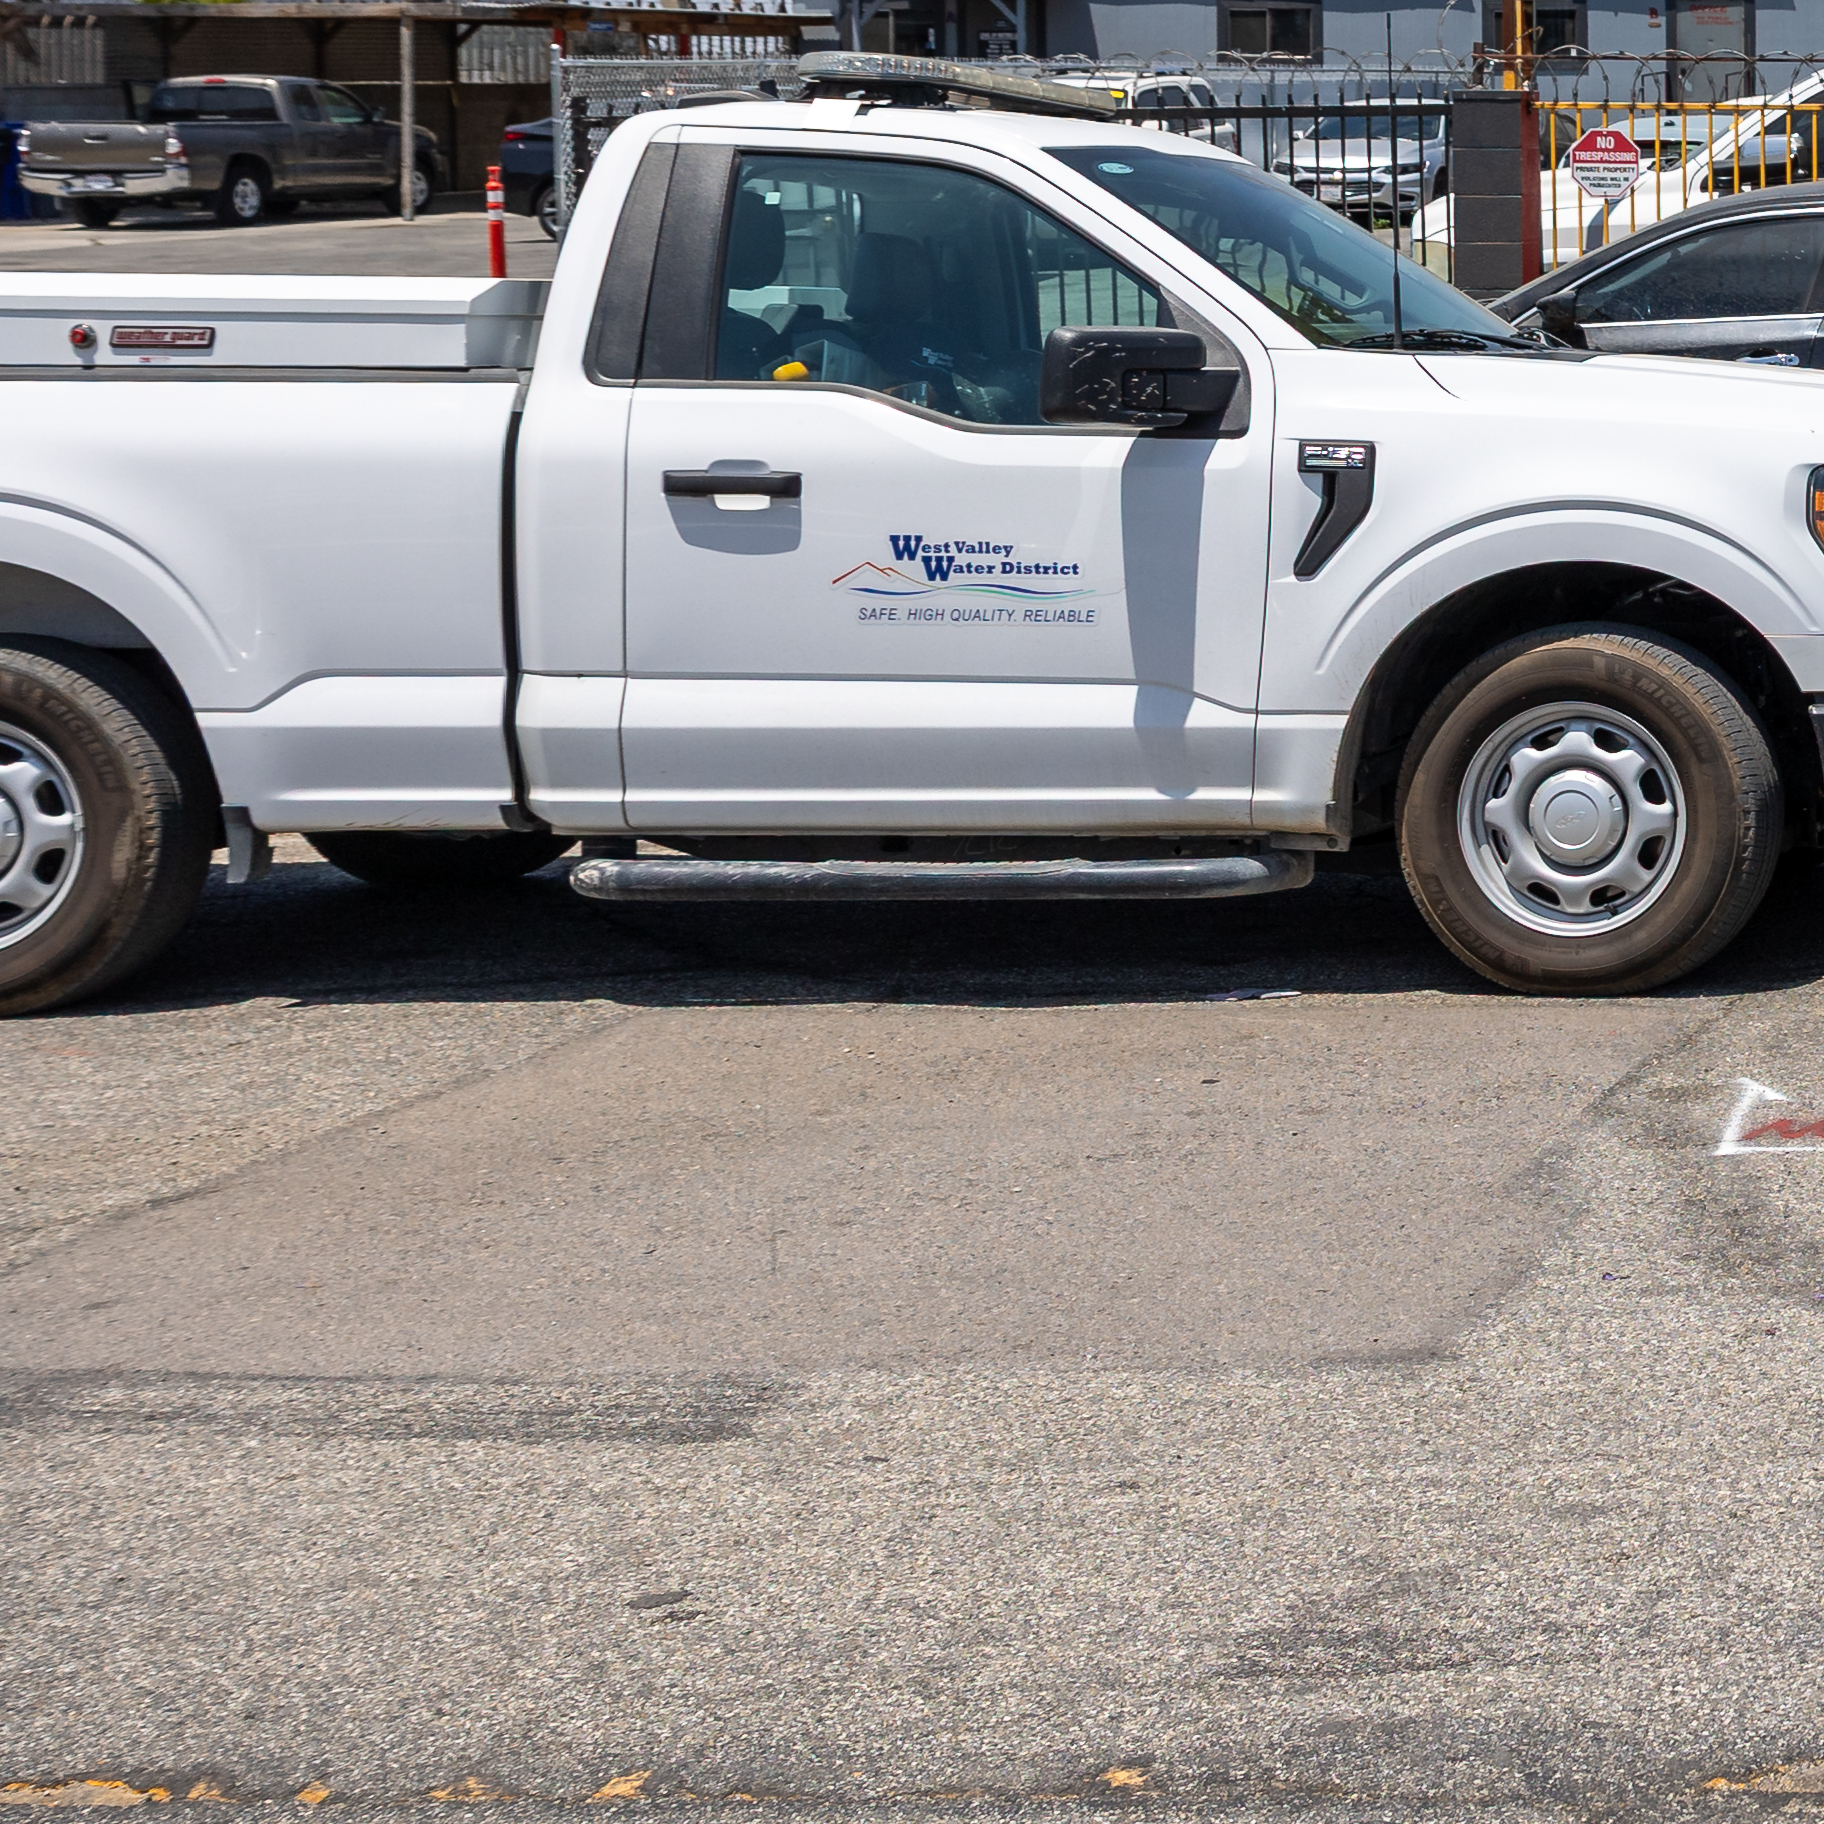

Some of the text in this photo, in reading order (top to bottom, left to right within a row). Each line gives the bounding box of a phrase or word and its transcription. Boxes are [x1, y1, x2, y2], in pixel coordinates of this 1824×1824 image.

[1596, 136, 1615, 149] NO
[1574, 151, 1637, 162] TRESPASSING
[1603, 166, 1635, 174] PROPERTY
[889, 534, 1014, 561] West Valley
[921, 555, 1079, 581] Water District
[858, 607, 1095, 623] SAFE. HIGH QUALITY. RELIABLE
